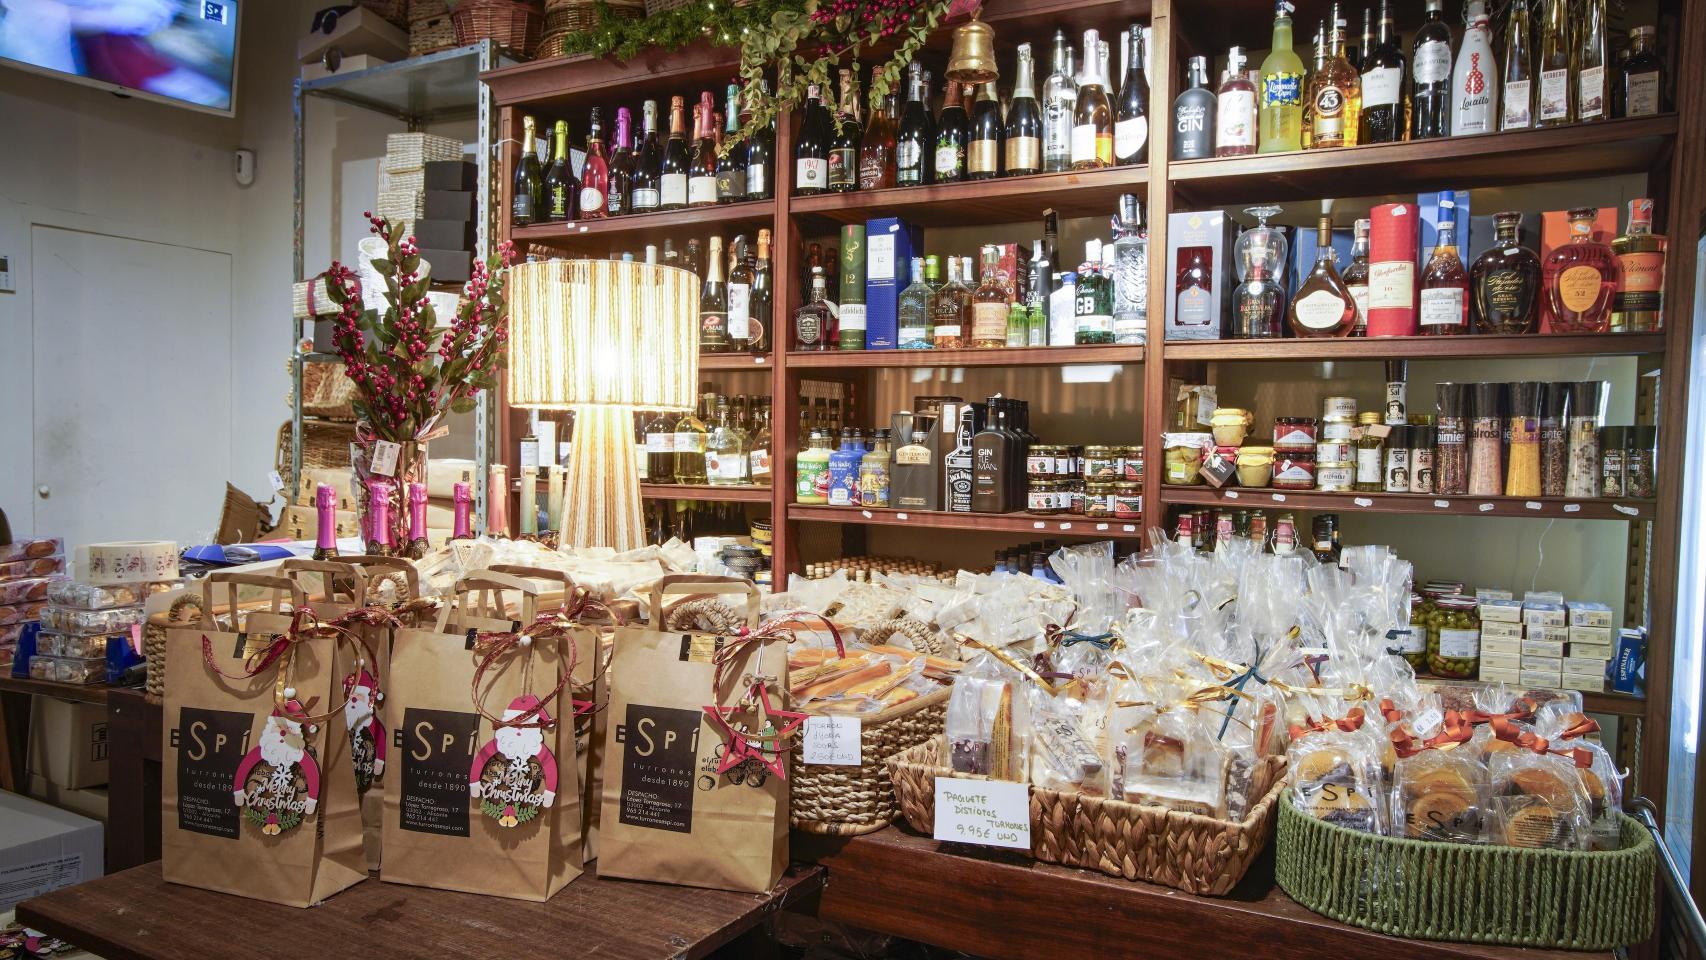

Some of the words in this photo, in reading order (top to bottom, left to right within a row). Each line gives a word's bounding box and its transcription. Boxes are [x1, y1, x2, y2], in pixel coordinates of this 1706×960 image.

[1319, 92, 1339, 108] 43
[1178, 118, 1203, 132] GIN
[845, 273, 856, 284] 12
[1076, 296, 1095, 315] GB
[1390, 387, 1400, 396] Sal
[977, 448, 993, 456] GIN
[1394, 454, 1405, 463] Sal
[186, 767, 233, 781] turrone
[410, 767, 468, 780] turrones
[633, 762, 692, 776] turrones
[218, 783, 233, 792] 189
[418, 781, 442, 790] desde
[444, 782, 466, 792] 1890
[499, 771, 532, 795] Merry
[641, 775, 665, 785] desde
[668, 780, 689, 788] 1890
[262, 777, 296, 800] Merry
[481, 781, 547, 807] Christmas
[245, 789, 306, 813] Christmas
[943, 791, 987, 804] PAQUETE
[986, 819, 1028, 832] TURRONES
[997, 832, 1018, 842] UND
